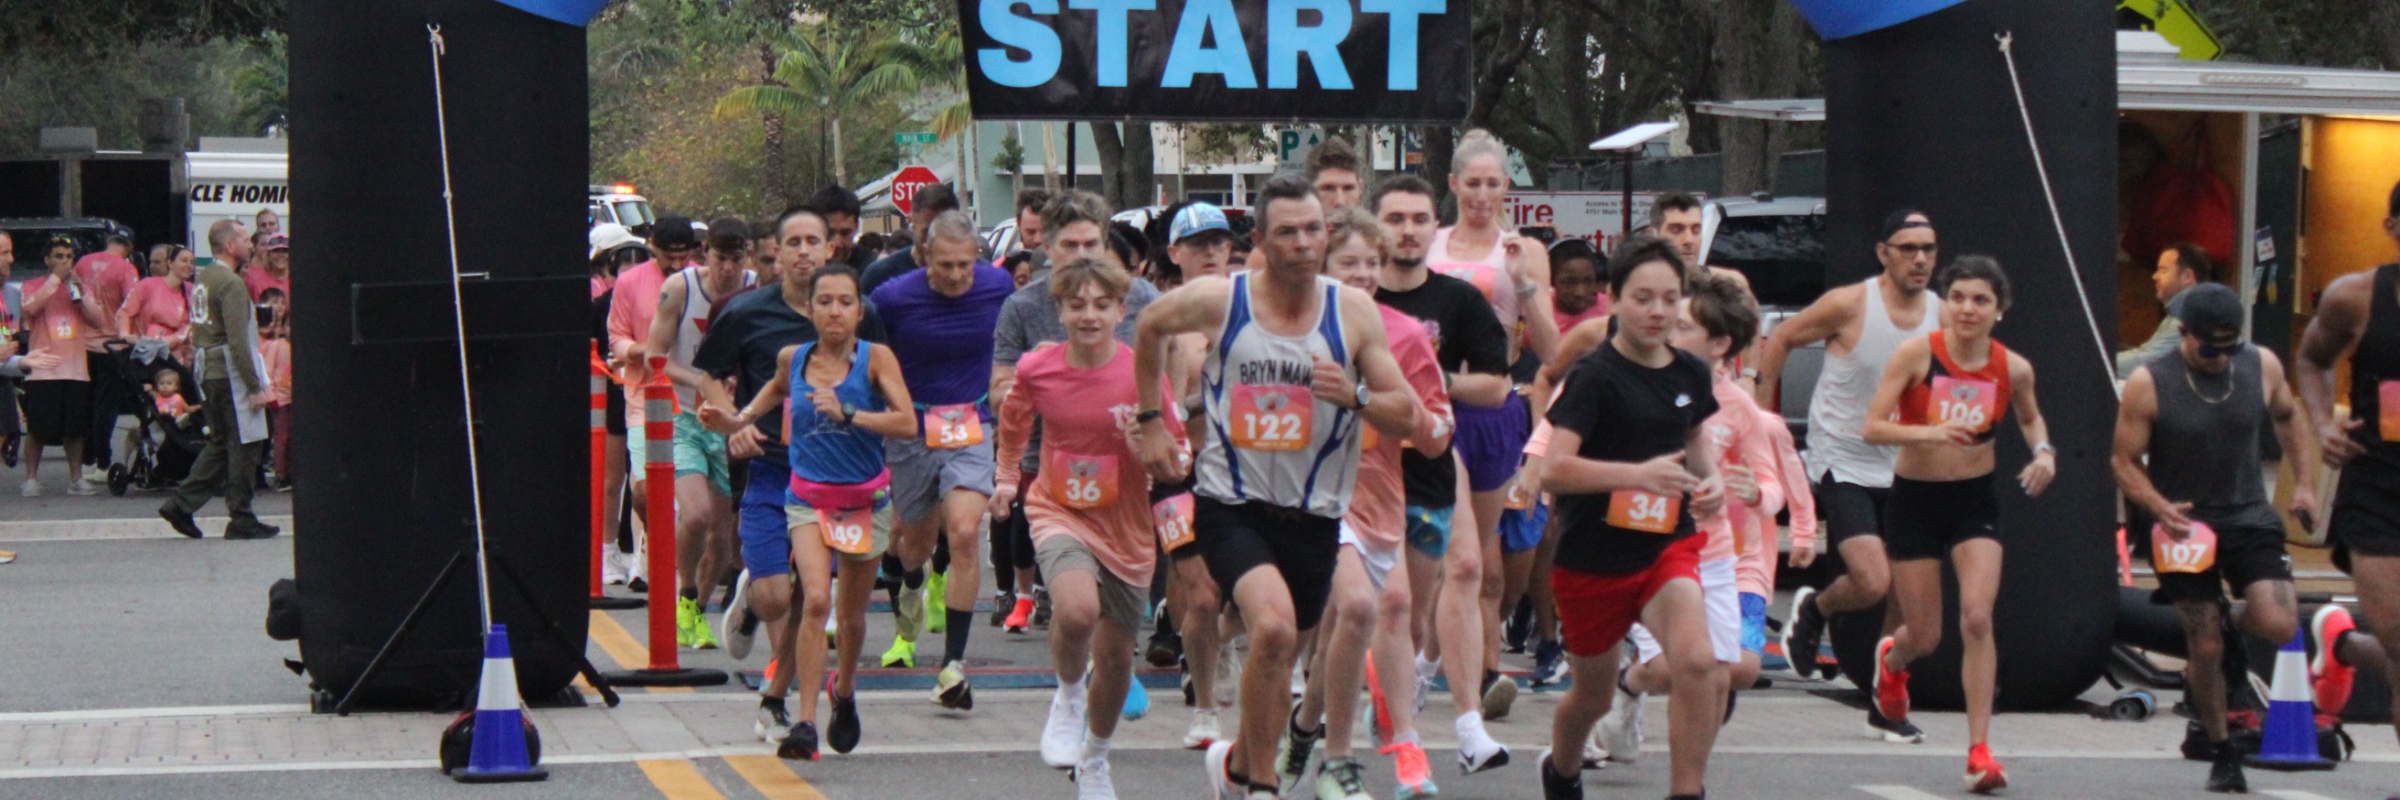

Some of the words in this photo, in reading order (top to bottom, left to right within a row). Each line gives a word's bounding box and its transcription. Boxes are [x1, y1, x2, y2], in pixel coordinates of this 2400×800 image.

[977, 0, 1447, 91] START
[1281, 131, 1300, 160] P
[229, 185, 287, 203] HOMI
[1240, 359, 1277, 386] BRYN
[1940, 400, 1985, 426] 106
[941, 424, 969, 444] 53
[1244, 413, 1302, 440] 122
[1065, 478, 1102, 502] 36
[1628, 493, 1668, 523] 34
[826, 521, 863, 546] 149
[1159, 515, 1190, 544] 181
[2161, 543, 2208, 566] 107
